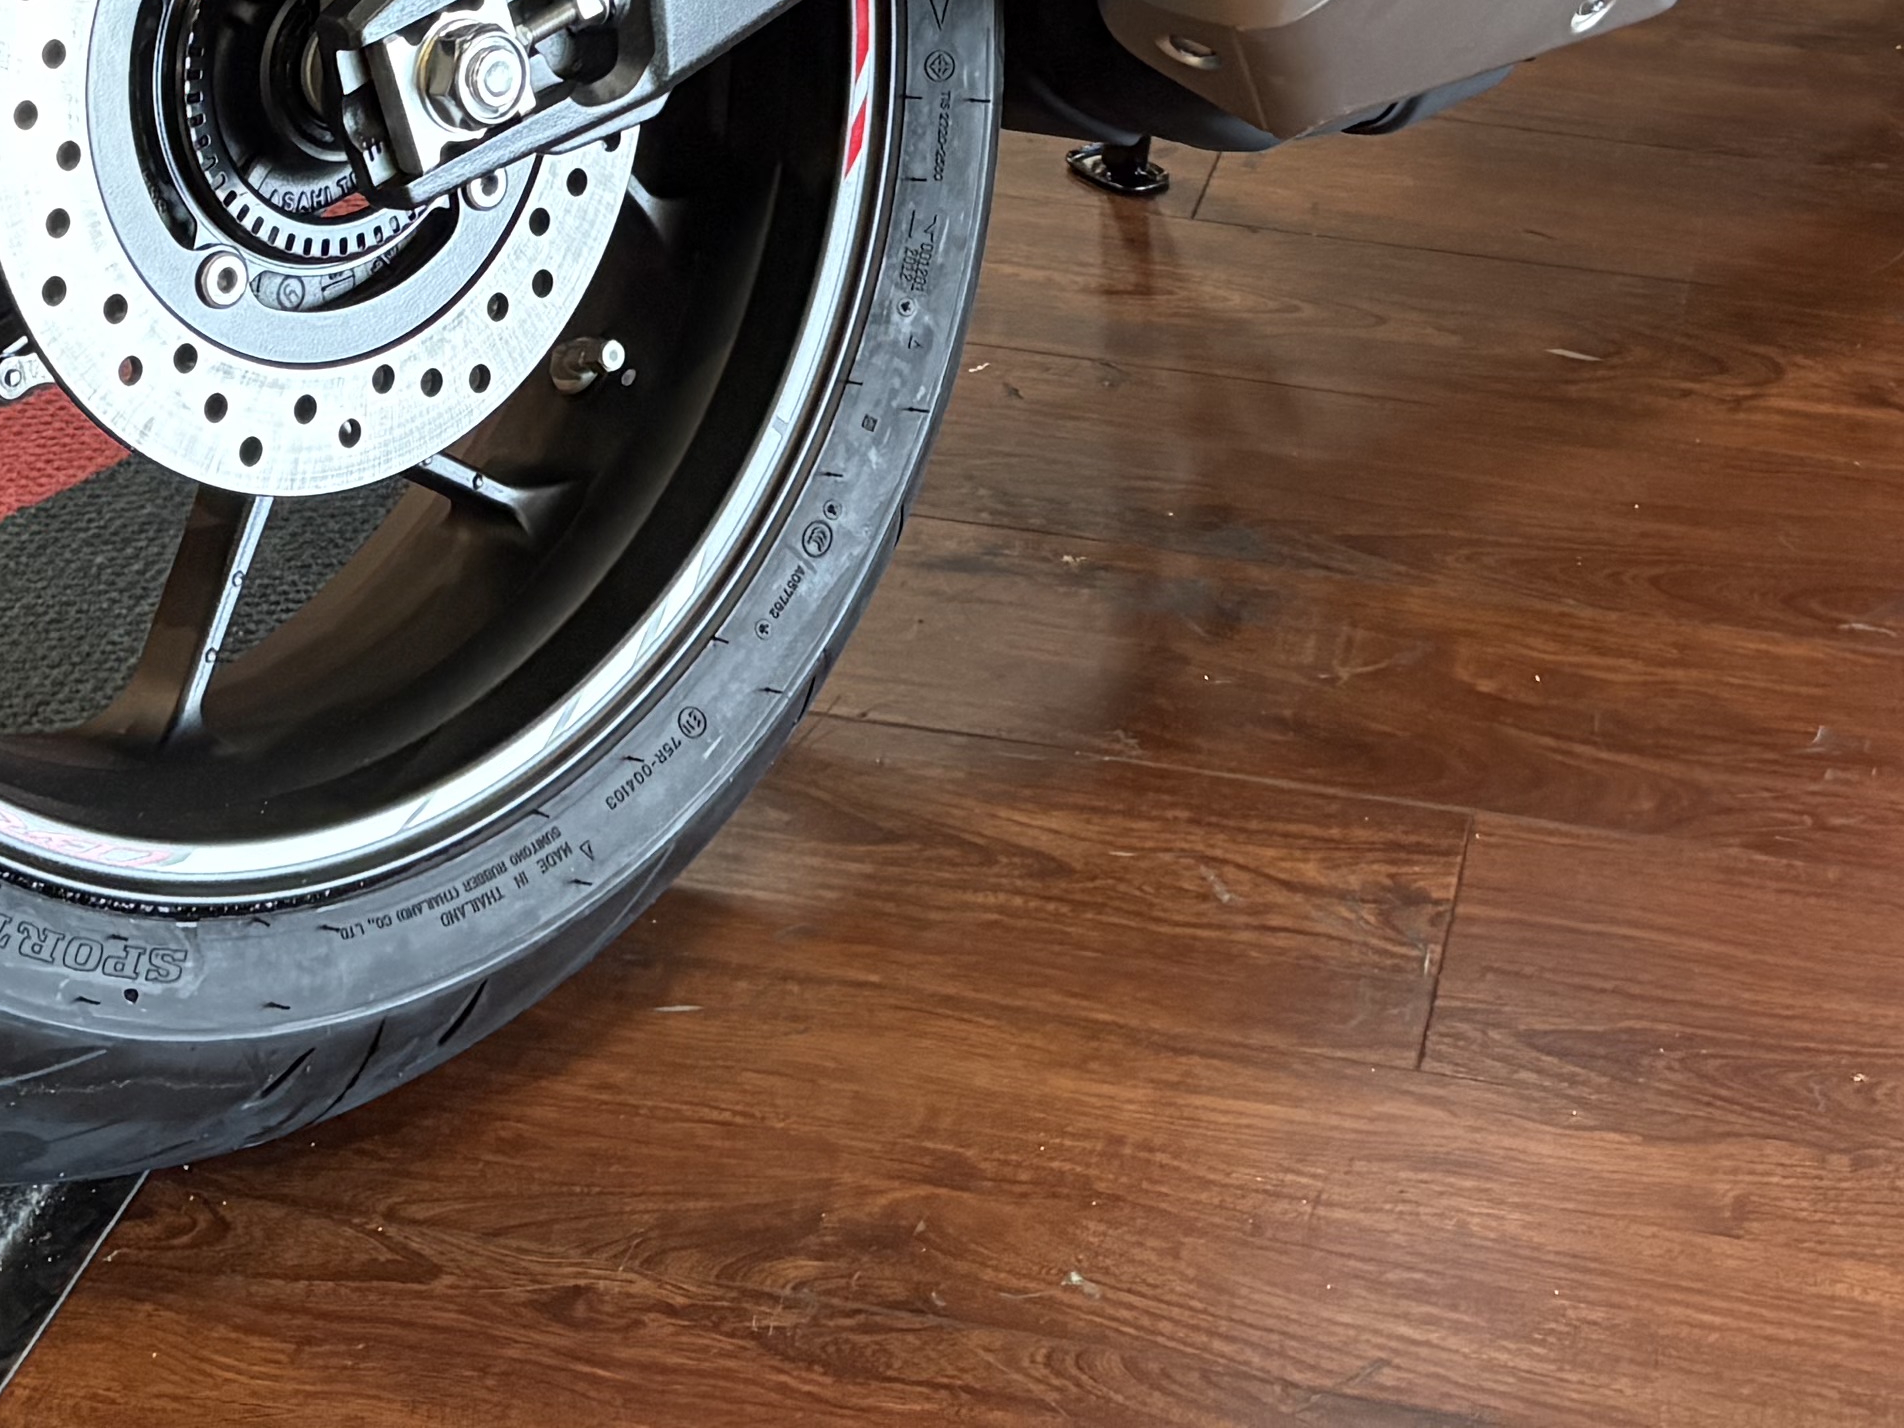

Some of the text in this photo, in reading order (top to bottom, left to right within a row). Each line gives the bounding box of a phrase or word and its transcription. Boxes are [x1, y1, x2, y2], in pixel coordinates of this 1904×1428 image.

[440, 841, 573, 928] MADE IN THAILAND
